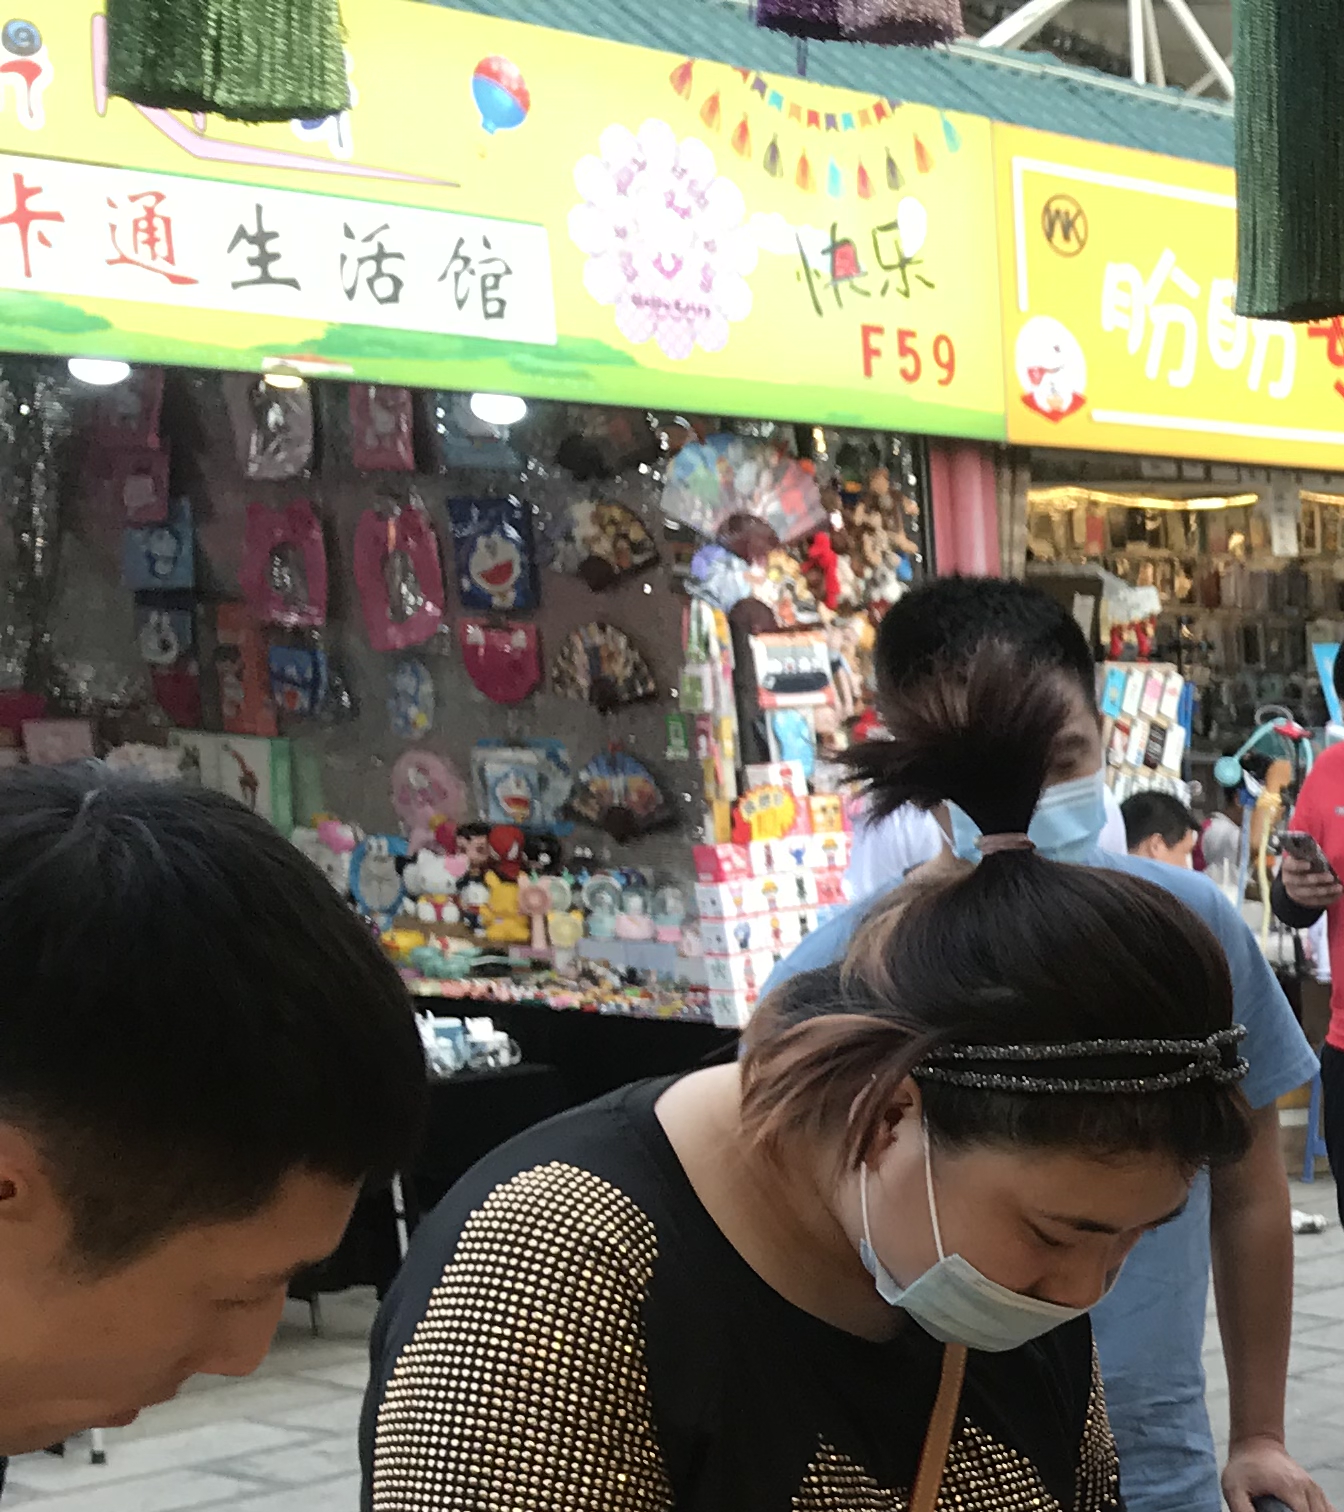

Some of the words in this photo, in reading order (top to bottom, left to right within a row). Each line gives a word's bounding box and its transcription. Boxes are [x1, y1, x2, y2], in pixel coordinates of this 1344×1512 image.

[0, 172, 513, 321] 卡通生活馆
[795, 220, 936, 318] 快乐
[860, 323, 956, 387] F59
